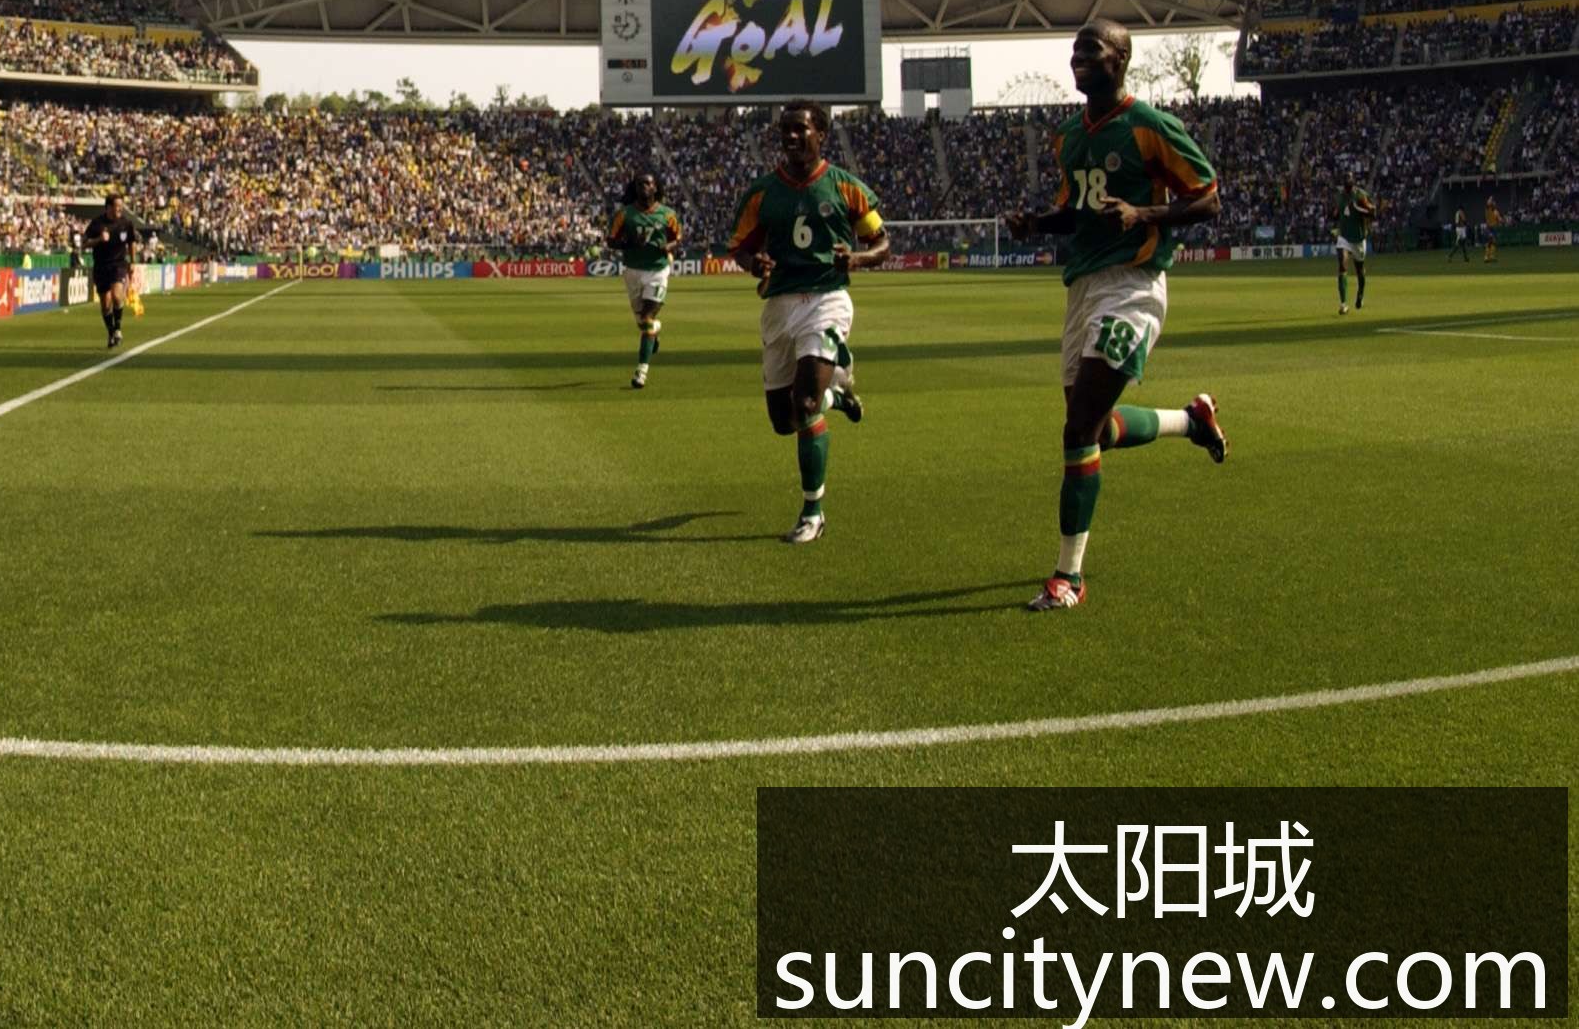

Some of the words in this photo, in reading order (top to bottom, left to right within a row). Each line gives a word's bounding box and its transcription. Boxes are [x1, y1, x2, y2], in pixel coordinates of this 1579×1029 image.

[1073, 169, 1109, 211] 18
[792, 215, 813, 249] 6
[970, 252, 1035, 267] MasterCard
[380, 262, 454, 279] PHILIPS
[507, 263, 533, 276] FUJI
[535, 262, 575, 276] XEROX
